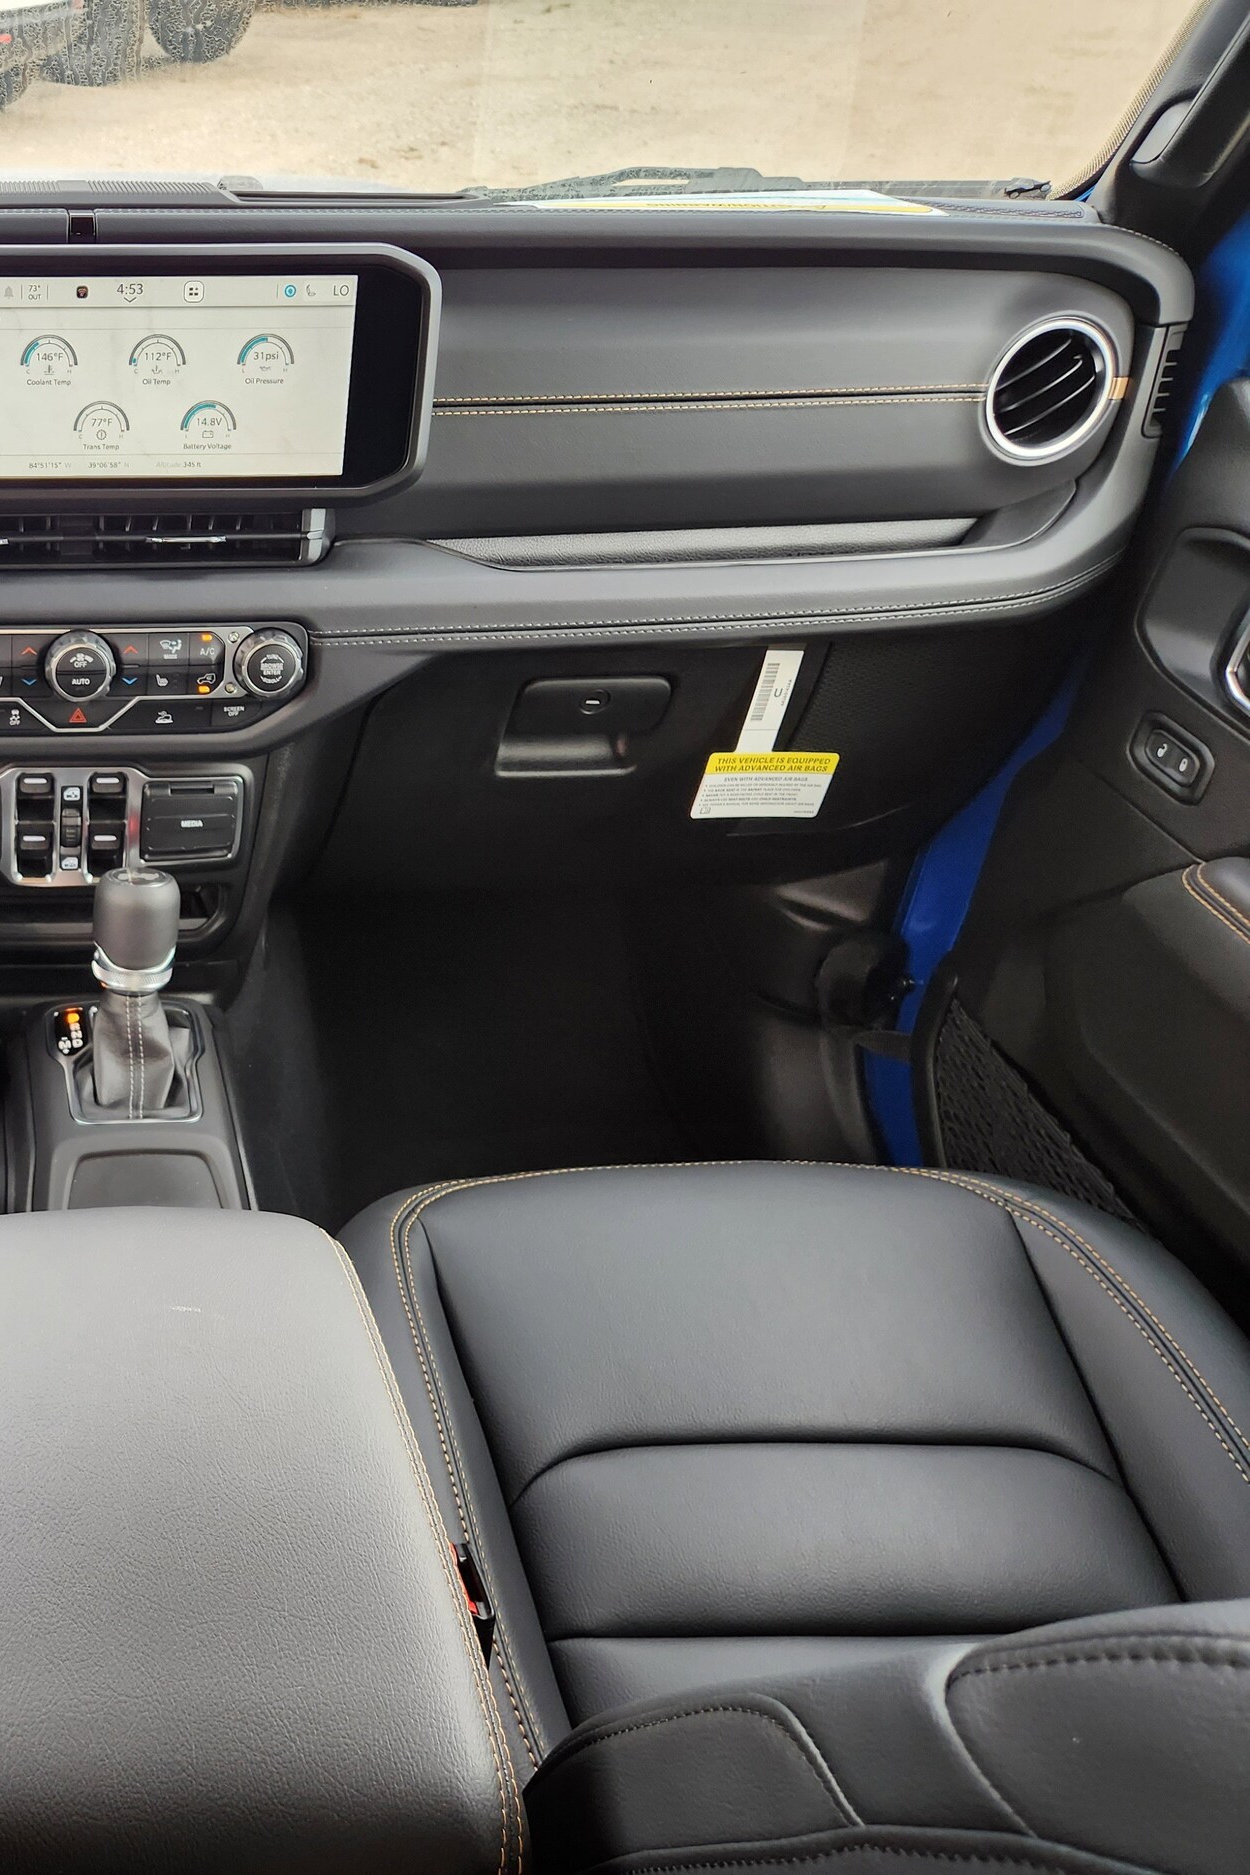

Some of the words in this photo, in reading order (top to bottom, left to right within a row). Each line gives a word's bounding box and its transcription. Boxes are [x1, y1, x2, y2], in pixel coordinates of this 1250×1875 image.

[116, 283, 144, 295] 4:53
[333, 285, 350, 296] LO
[36, 352, 64, 361] 146°F
[144, 352, 172, 361] 112°F
[54, 379, 71, 387] Temp
[153, 378, 171, 386] Temp
[245, 377, 254, 385] Oil
[91, 418, 113, 427] 77°F
[196, 417, 223, 426] 14.8V
[102, 443, 120, 451] Temp
[200, 647, 215, 655] A/C
[787, 757, 830, 765] EQUIPPED
[181, 820, 203, 828] MEDIA
[71, 1030, 83, 1039] N
[58, 1040, 71, 1050] M
[72, 1039, 83, 1048] D
